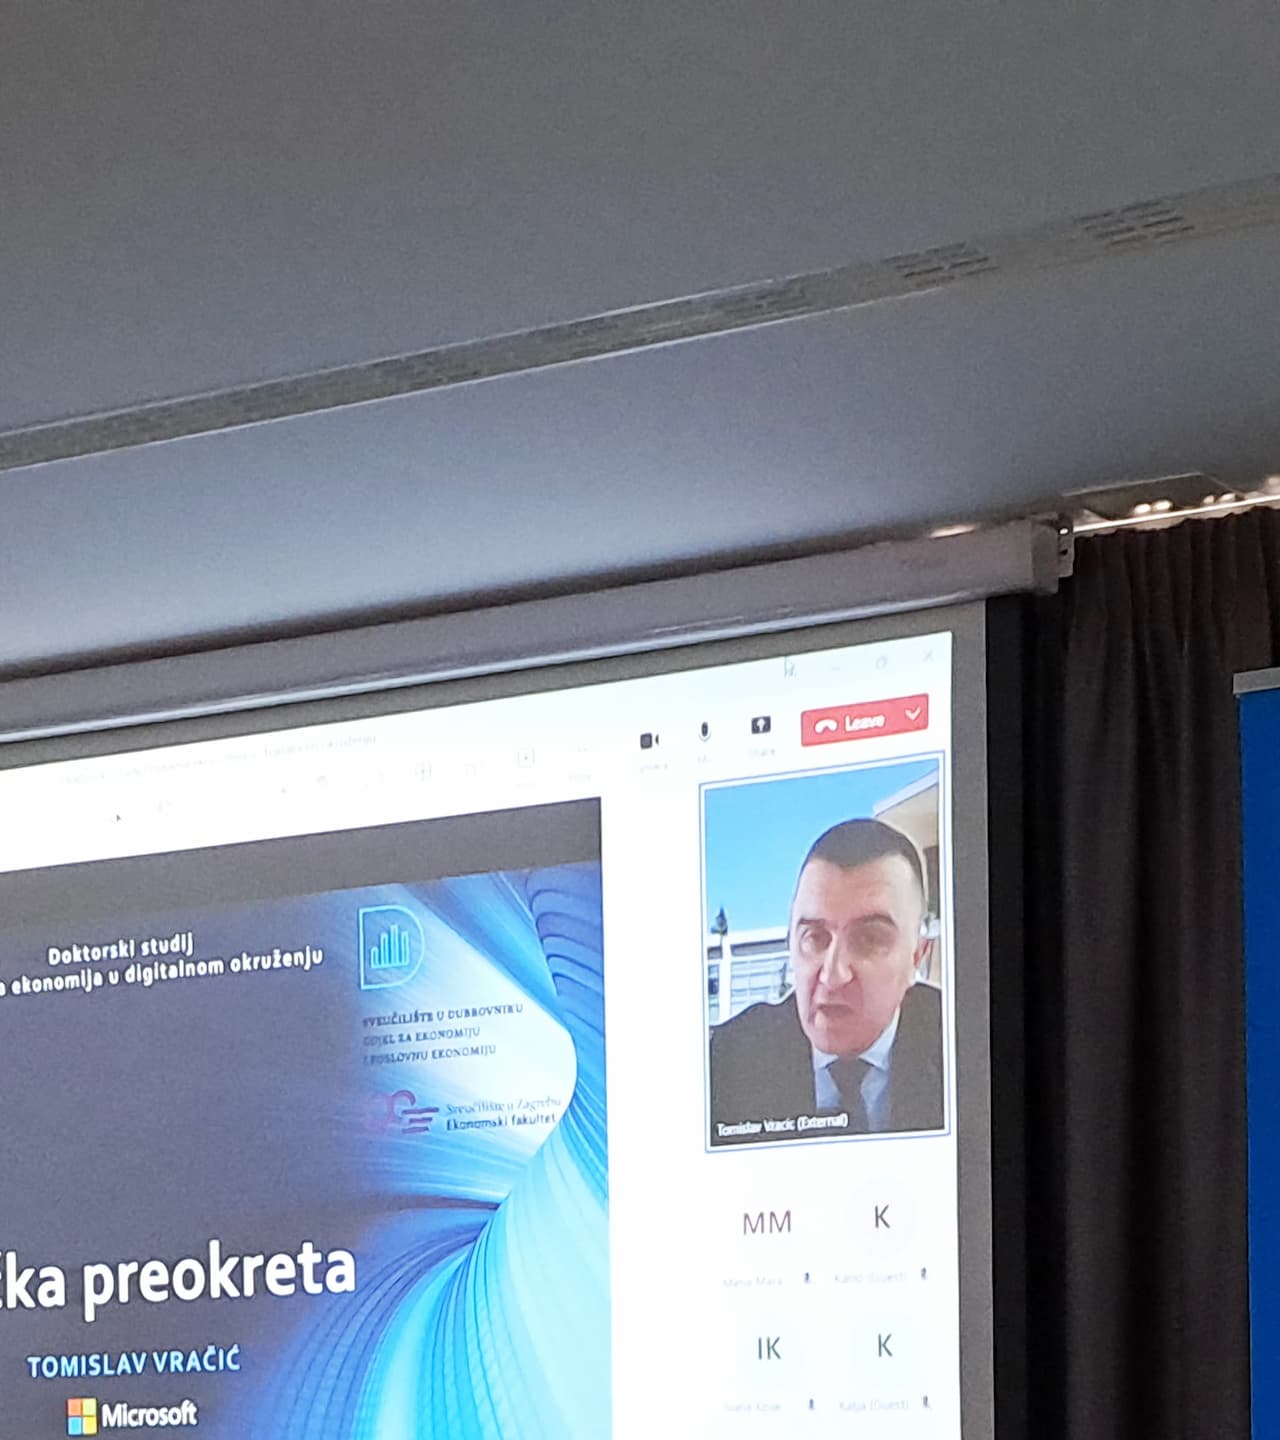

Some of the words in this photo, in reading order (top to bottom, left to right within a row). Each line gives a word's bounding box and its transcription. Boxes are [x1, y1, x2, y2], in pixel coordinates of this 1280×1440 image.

[845, 714, 885, 732] Leave
[48, 940, 135, 966] Doktorski
[140, 932, 194, 957] studij
[11, 969, 103, 993] ekonomija
[108, 971, 120, 985] u
[124, 958, 224, 987] digitalnom
[229, 945, 323, 972] okruženju
[436, 1009, 445, 1021] U
[448, 1004, 524, 1020] DUBROVNIKU
[416, 1027, 481, 1043] EKONOMIJU
[432, 1045, 497, 1061] EKONOMIJU
[447, 1117, 508, 1132] Ekonomski
[512, 1114, 556, 1127] fakultet
[797, 1112, 848, 1133] (External)
[743, 1209, 792, 1236] MM
[874, 1204, 891, 1230] K
[83, 1239, 357, 1324] preokreta
[757, 1335, 782, 1361] IK
[878, 1332, 893, 1358] K
[26, 1352, 147, 1380] TOMISLAV
[150, 1343, 242, 1374] VRAČIĆ
[101, 1399, 198, 1428] Microsoft
